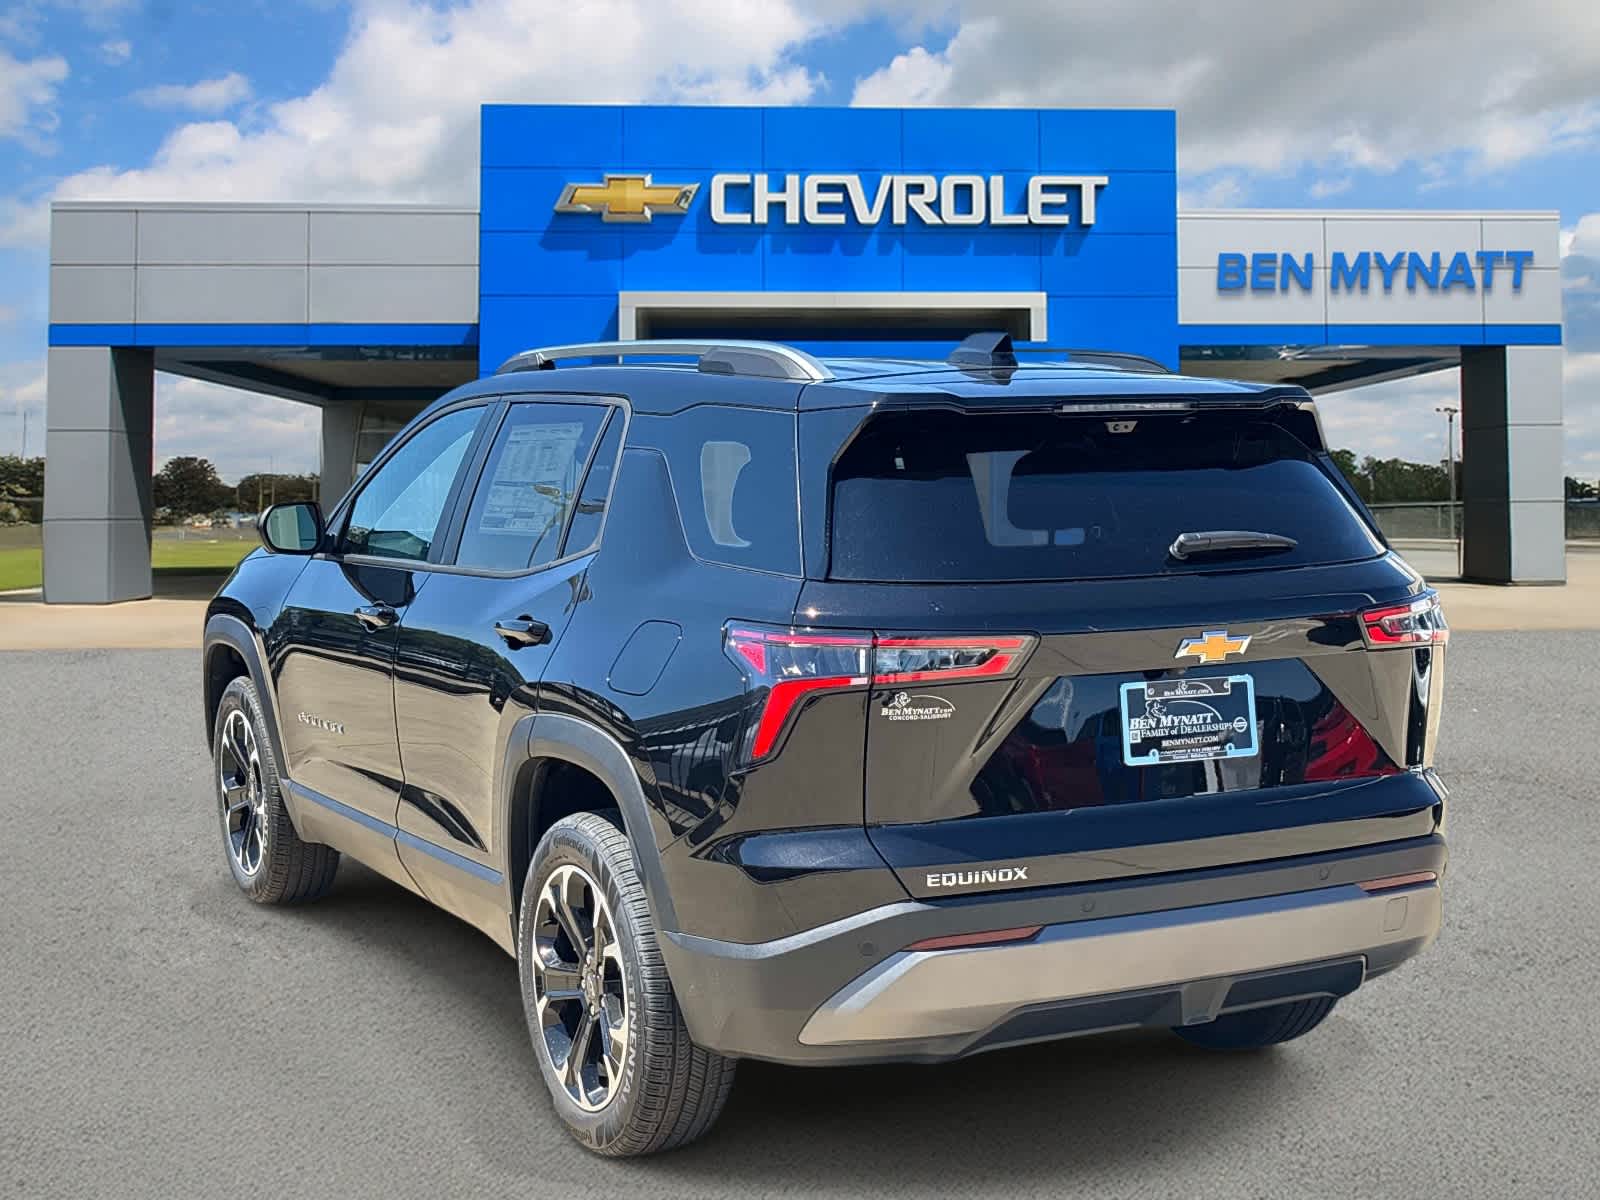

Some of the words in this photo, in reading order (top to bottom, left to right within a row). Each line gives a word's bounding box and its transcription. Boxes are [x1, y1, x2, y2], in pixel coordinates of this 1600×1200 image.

[710, 173, 1109, 225] CHEVROLET
[1217, 252, 1313, 290] BEN
[1330, 250, 1534, 290] MYNATT
[881, 707, 902, 716] BEN
[1130, 718, 1157, 730] BEN
[1159, 712, 1214, 728] MYNATT
[1141, 727, 1170, 738] FAMILY
[1170, 726, 1179, 736] of
[1180, 723, 1233, 735] DEALERSHIPS
[1161, 735, 1219, 747] BENMYNATT.COM
[926, 866, 1028, 887] EQUINOX
